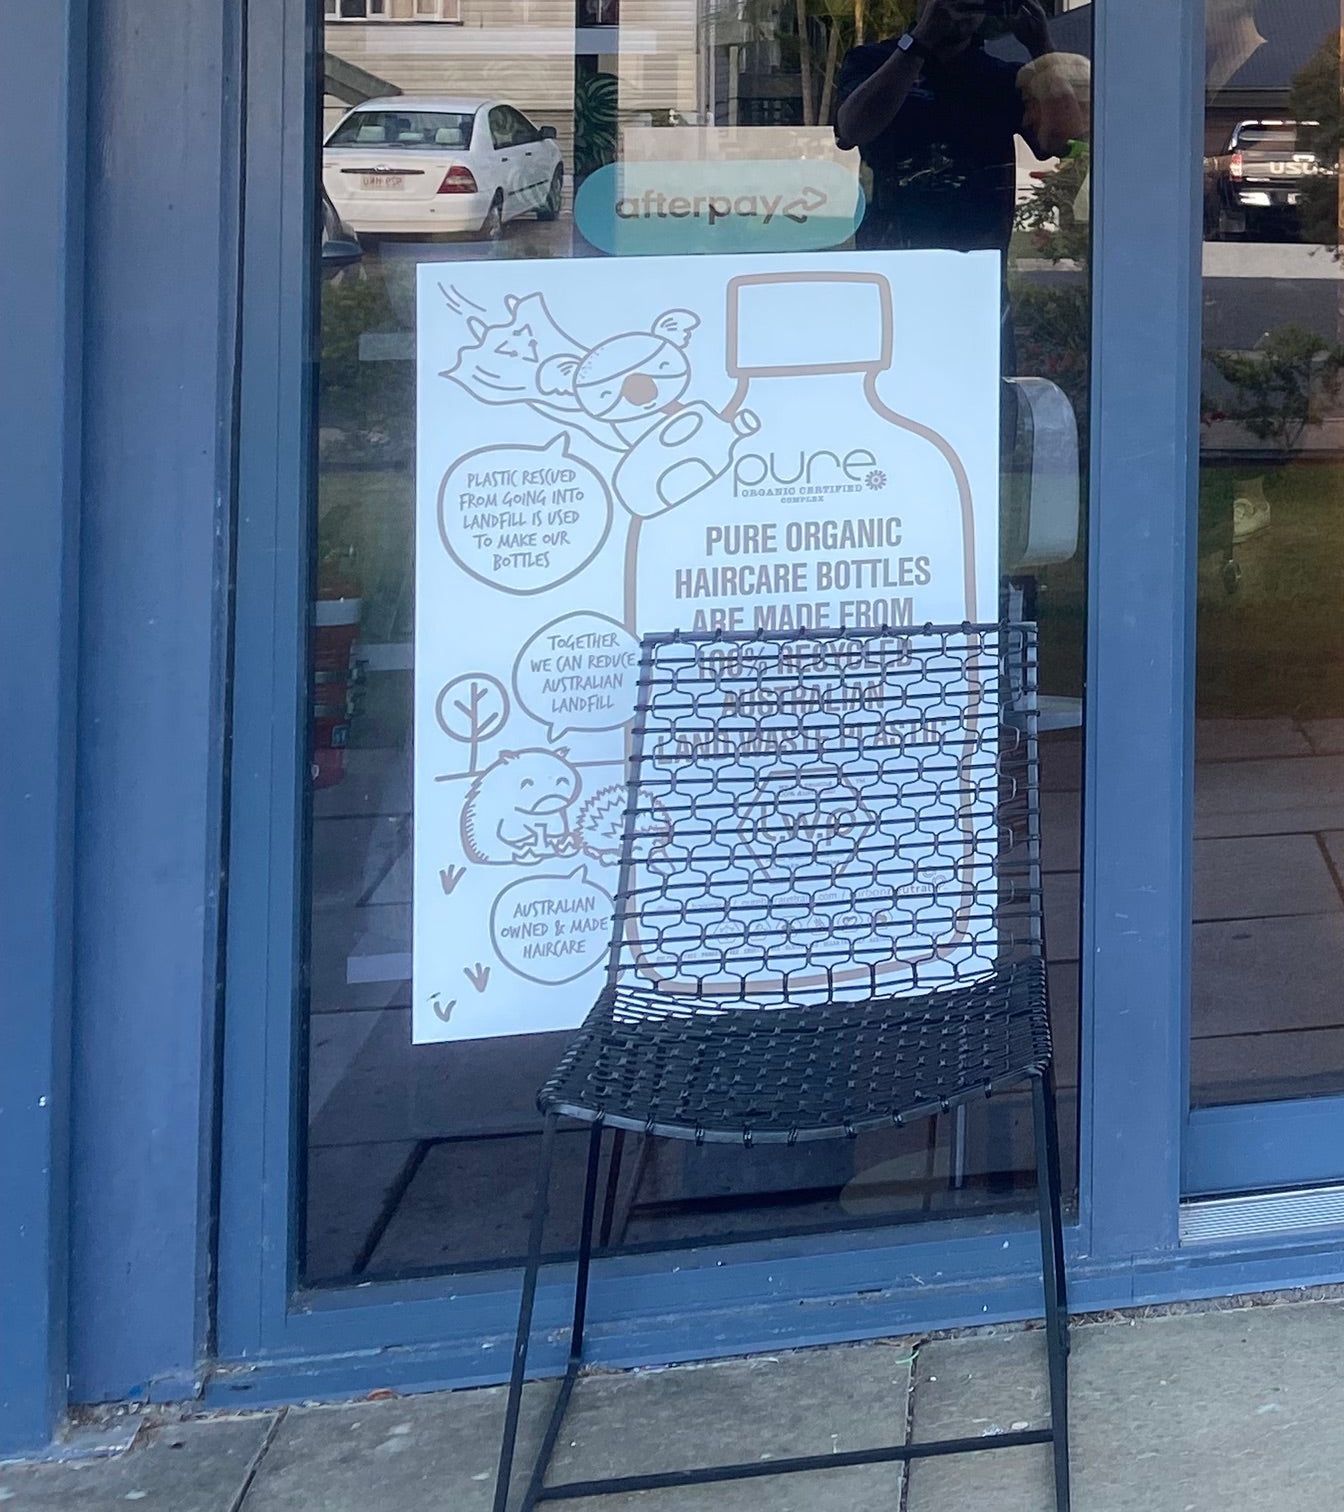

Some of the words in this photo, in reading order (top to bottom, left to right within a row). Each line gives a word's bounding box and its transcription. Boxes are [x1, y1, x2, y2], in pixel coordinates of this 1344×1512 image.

[615, 189, 783, 228] afterpay
[467, 470, 519, 489] PLASTIC
[522, 467, 577, 488] RESCUED
[733, 447, 877, 498] pure
[458, 491, 497, 511] FROM
[501, 488, 548, 509] GOING
[552, 487, 585, 506] INTO
[741, 486, 796, 498] ORGANIC
[799, 483, 863, 496] CERTIFIED
[780, 495, 824, 504] COMPLEX
[463, 509, 526, 529] LANDFILL
[531, 510, 542, 527] IS
[546, 508, 580, 527] USED
[474, 532, 491, 551] TO
[496, 531, 538, 549] MAKE
[543, 530, 571, 548] OUR
[705, 523, 780, 556] PURE
[785, 517, 902, 552] ORGANIC
[492, 550, 550, 570] BOTTLES
[675, 563, 808, 599] HAIRCARE
[816, 555, 932, 593] BOTTLES
[692, 605, 744, 633] ARE
[753, 600, 832, 630] MADE
[838, 596, 914, 628] FROM
[547, 633, 620, 650] TOGETHER
[530, 657, 554, 673] WE
[557, 656, 583, 672] CAN
[586, 653, 636, 669] REDUCE
[778, 638, 913, 675] RECYCLED
[542, 674, 624, 694] AUSTRALIAN
[551, 693, 614, 711] LANDFILL
[722, 681, 885, 717] AUSTRALIAN
[513, 897, 595, 919] AUSTRALIAN
[501, 920, 549, 941] OWNED
[554, 920, 567, 937] &
[571, 916, 609, 934] MADE
[523, 938, 586, 956] HAIRCARE
